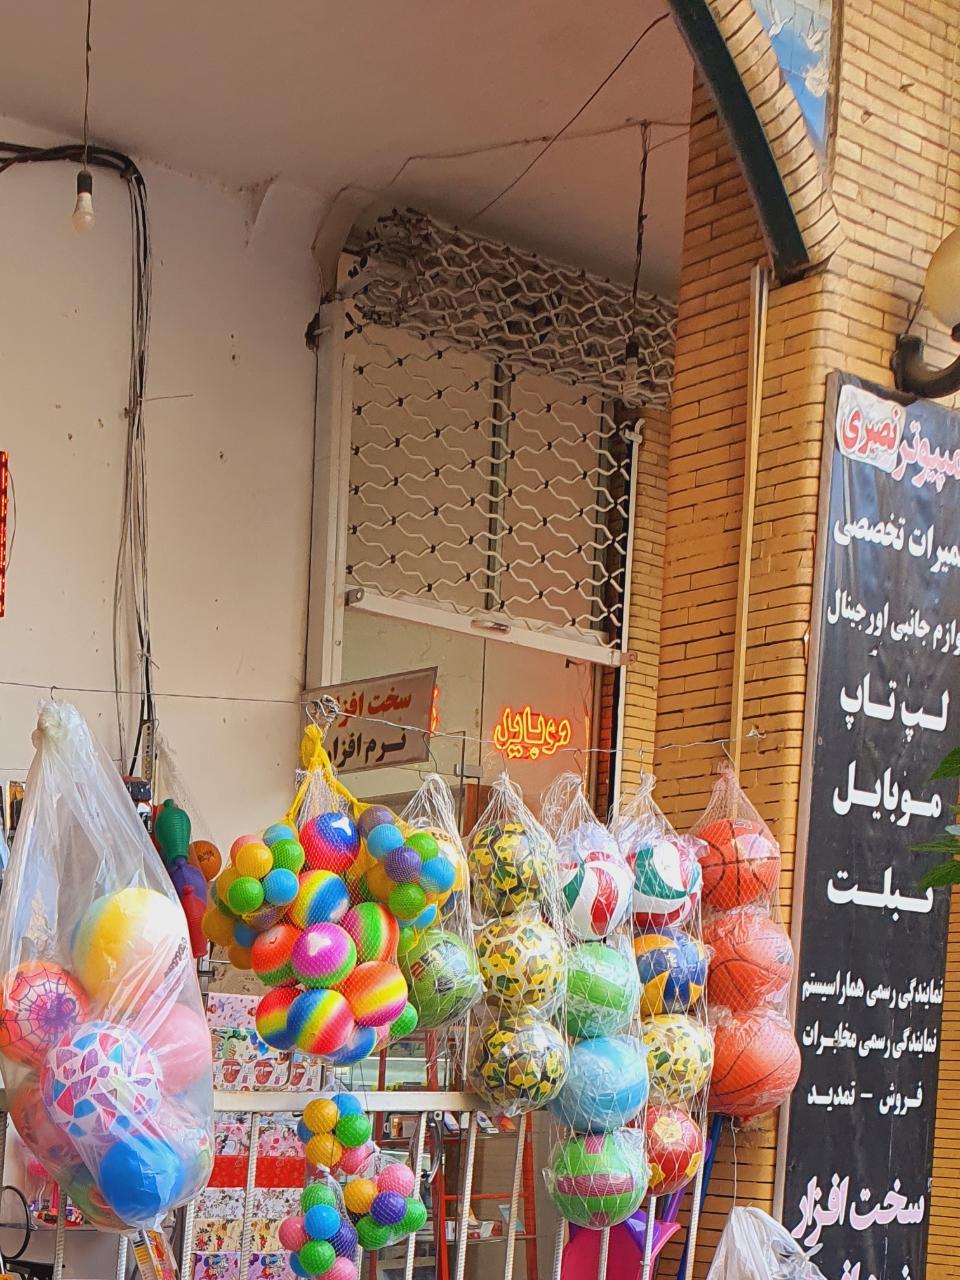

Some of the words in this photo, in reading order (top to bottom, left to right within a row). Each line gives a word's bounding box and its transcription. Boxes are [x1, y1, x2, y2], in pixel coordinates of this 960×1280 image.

[841, 406, 900, 455] نصیری
[892, 420, 960, 492] مپیوتر
[834, 513, 905, 550] تخصصی
[908, 524, 960, 572] میرات
[891, 609, 930, 645] جانبی
[933, 619, 960, 655] وازم
[336, 691, 364, 727] افز
[368, 687, 411, 715] سخت
[840, 672, 897, 730] تاپ
[901, 689, 950, 742] لپ
[365, 728, 406, 764] نرم
[494, 706, 571, 759] موبایل
[833, 760, 941, 827] موبایل
[866, 984, 896, 1008] رسمی
[898, 977, 943, 1009] نمایندگی
[803, 1020, 856, 1054] مخابرات
[859, 1034, 890, 1058] رسمی
[892, 1027, 937, 1058] نمایندگی
[880, 1081, 922, 1115] فروش
[791, 1173, 849, 1246] افزار
[850, 1178, 924, 1230] سخت
